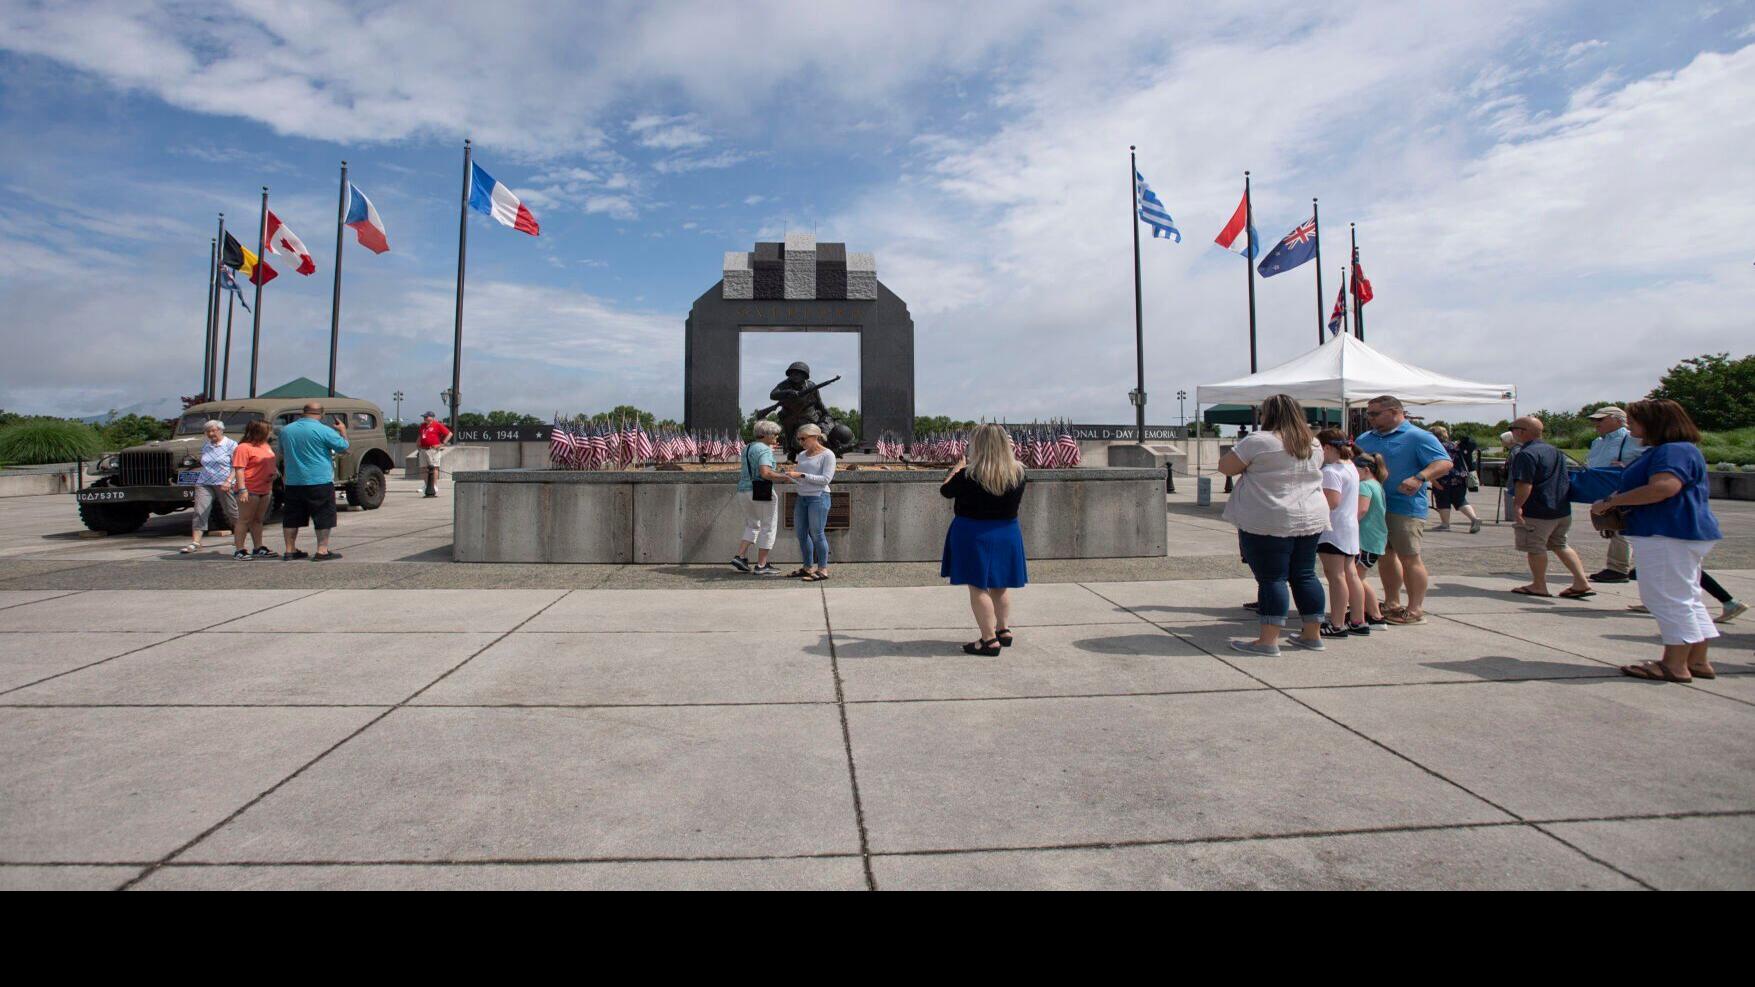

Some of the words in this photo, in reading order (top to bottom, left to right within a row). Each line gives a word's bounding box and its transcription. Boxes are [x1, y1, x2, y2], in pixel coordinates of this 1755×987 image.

[458, 430, 478, 440] UNE
[482, 430, 492, 441] 6,
[496, 430, 519, 440] 1944
[1072, 429, 1098, 439] ONAL
[1102, 429, 1134, 439] D-DAY
